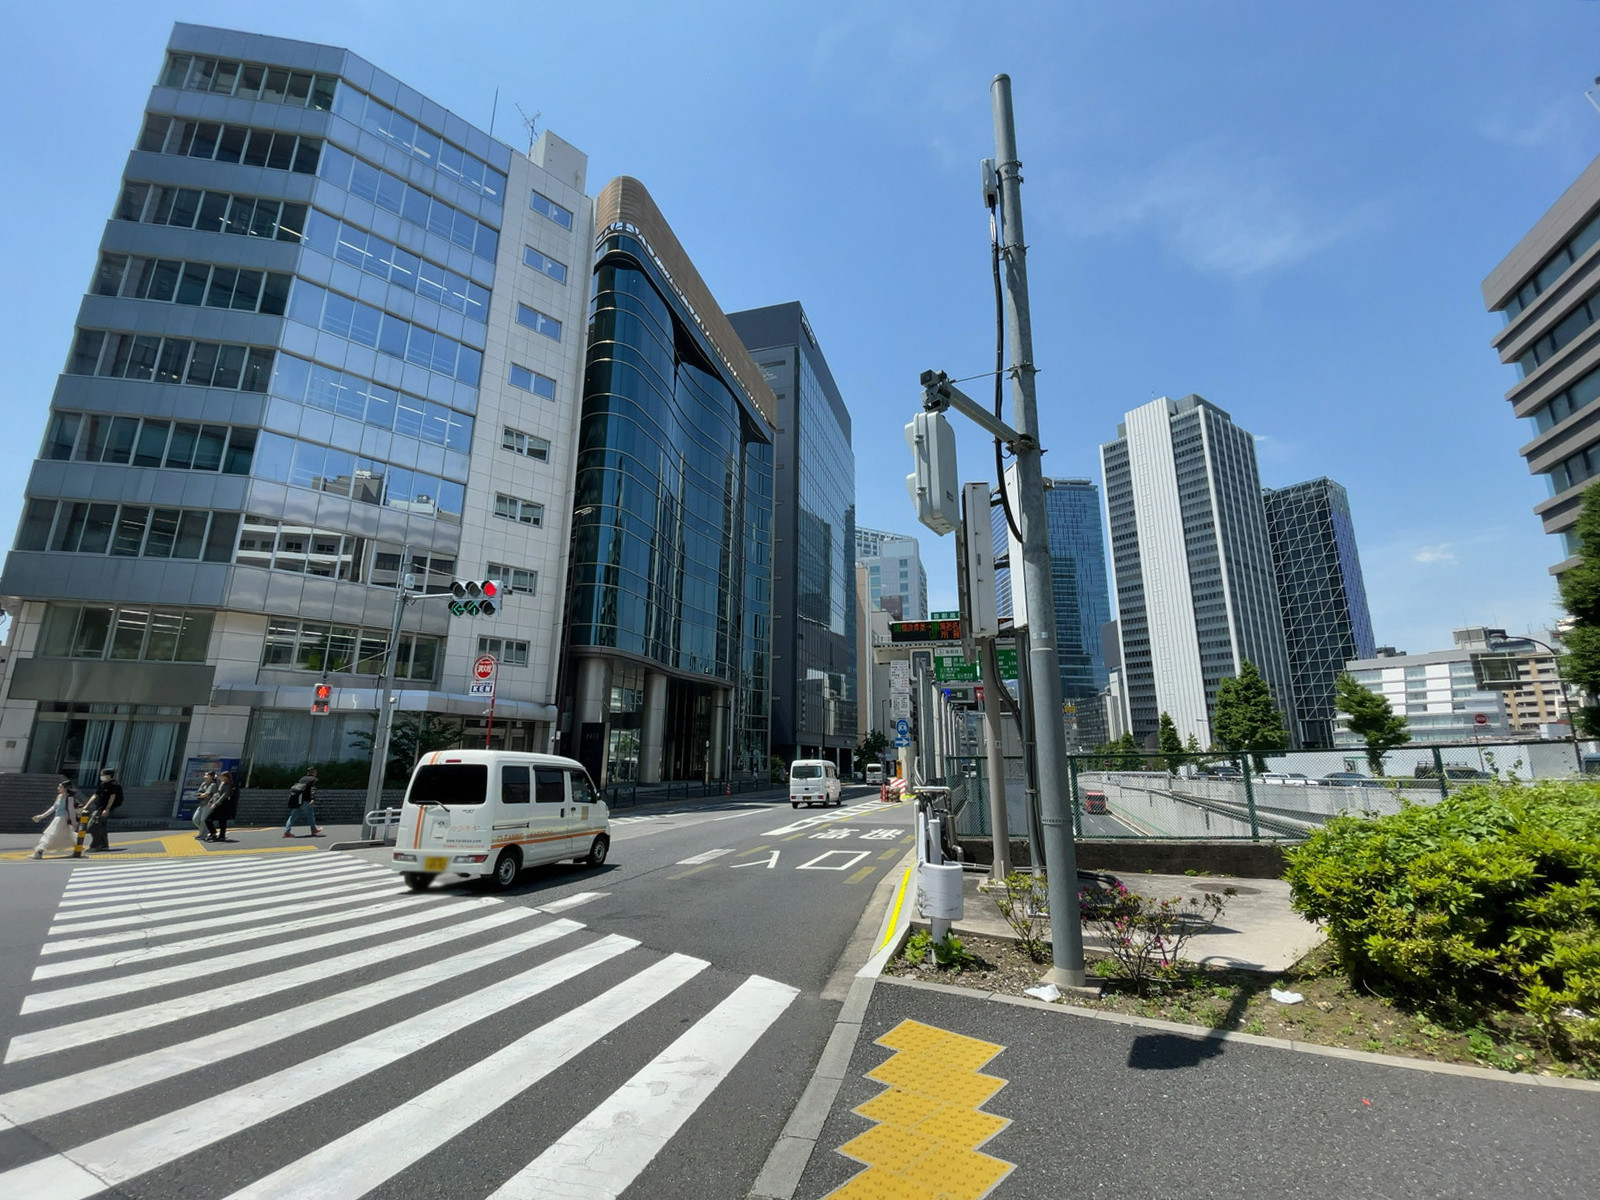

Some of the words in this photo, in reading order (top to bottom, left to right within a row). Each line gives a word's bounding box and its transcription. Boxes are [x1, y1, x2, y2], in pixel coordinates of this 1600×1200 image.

[473, 685, 491, 693] KEN
[808, 828, 905, 840] 高速
[730, 850, 872, 871] 入口
